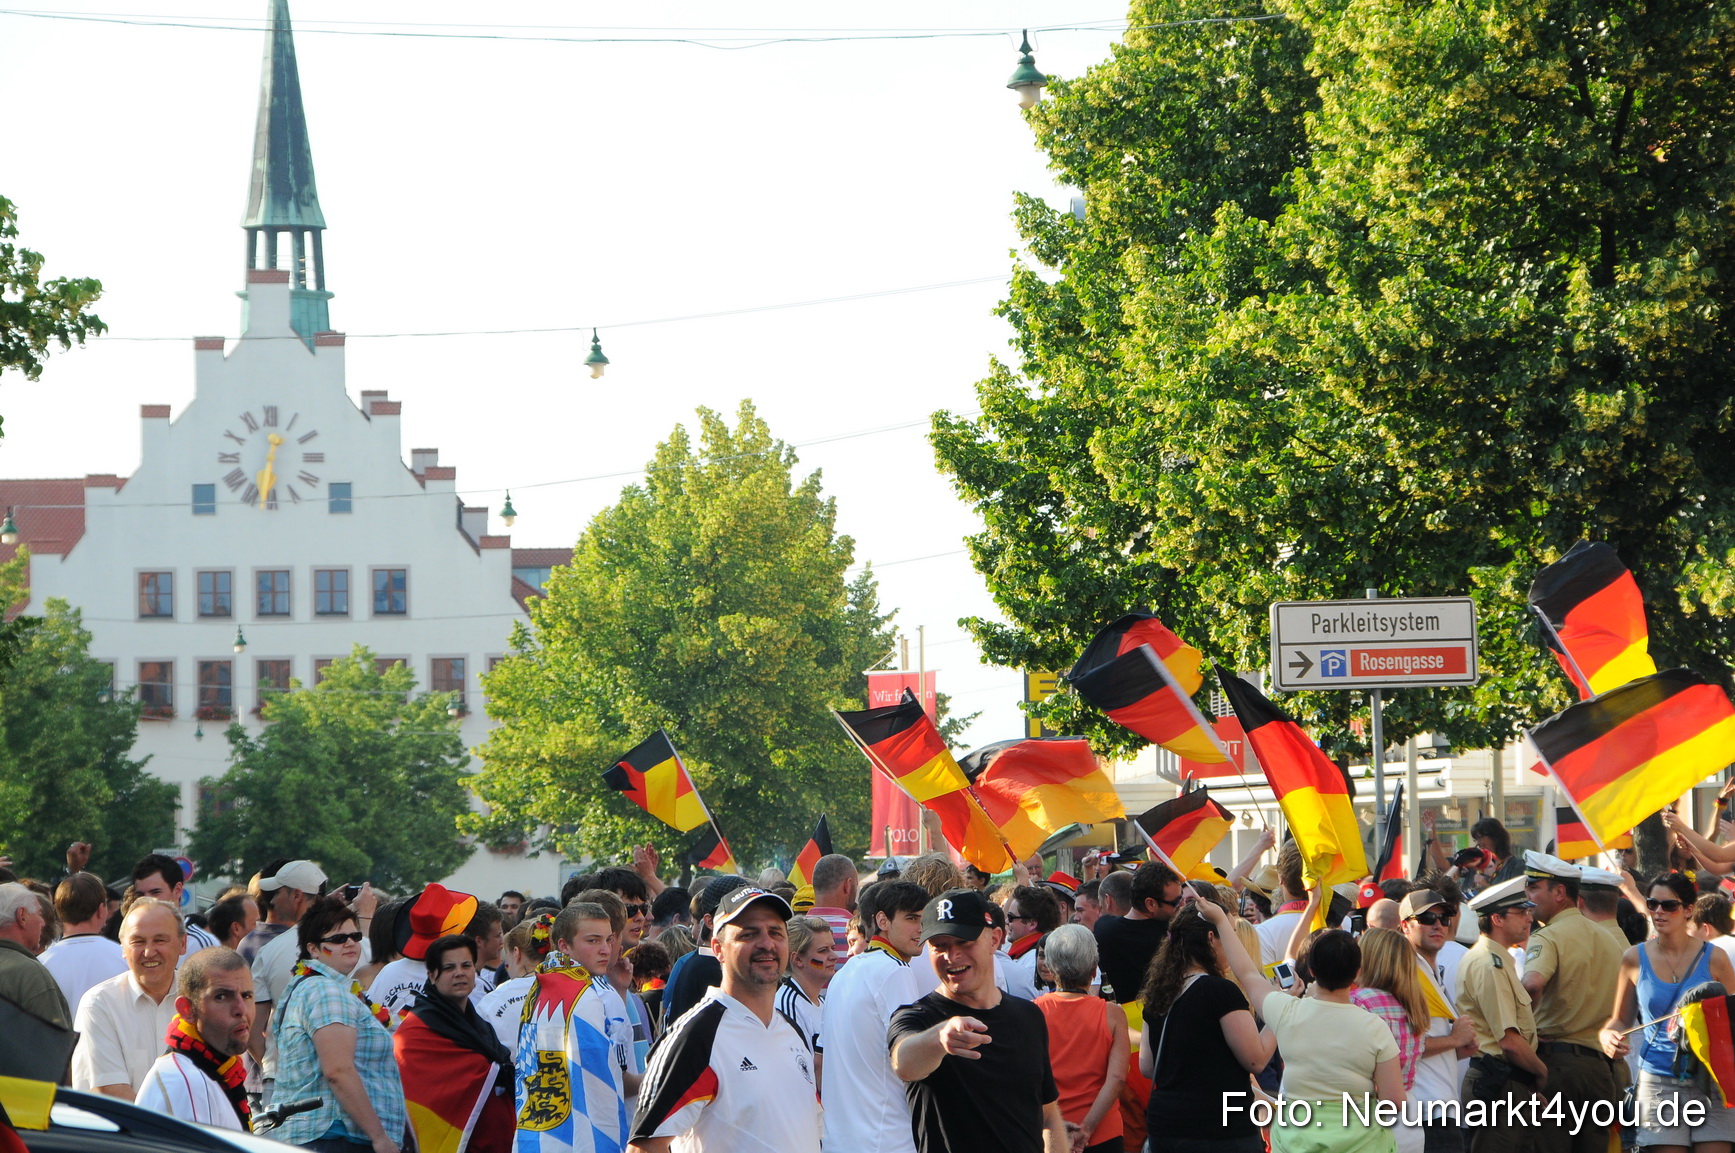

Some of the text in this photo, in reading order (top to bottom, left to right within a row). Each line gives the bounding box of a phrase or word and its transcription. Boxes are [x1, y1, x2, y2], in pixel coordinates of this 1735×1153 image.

[1311, 611, 1440, 637] Parkleitsystem
[1328, 652, 1445, 676] P Rosengasse
[873, 690, 893, 702] Wir
[892, 828, 919, 843] 010
[936, 898, 954, 921] R
